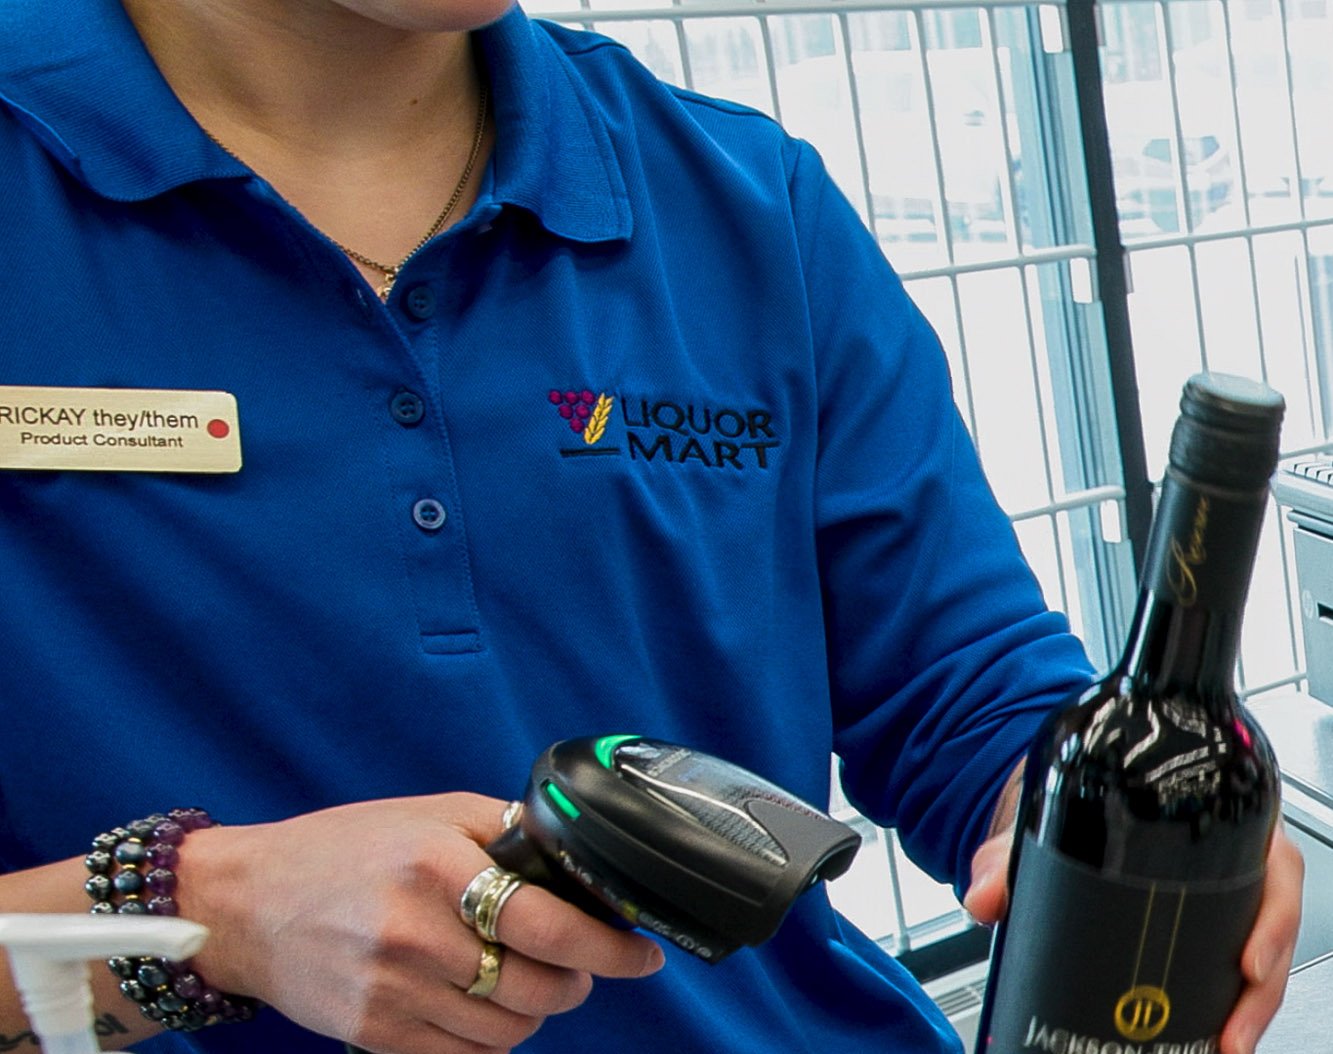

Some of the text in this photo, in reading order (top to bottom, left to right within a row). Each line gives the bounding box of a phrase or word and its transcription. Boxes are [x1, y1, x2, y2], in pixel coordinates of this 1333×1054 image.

[0, 406, 199, 431] RICKAY they/them
[620, 397, 775, 439] LIQUOR
[21, 432, 184, 448] Product Consultant
[627, 431, 781, 470] MART
